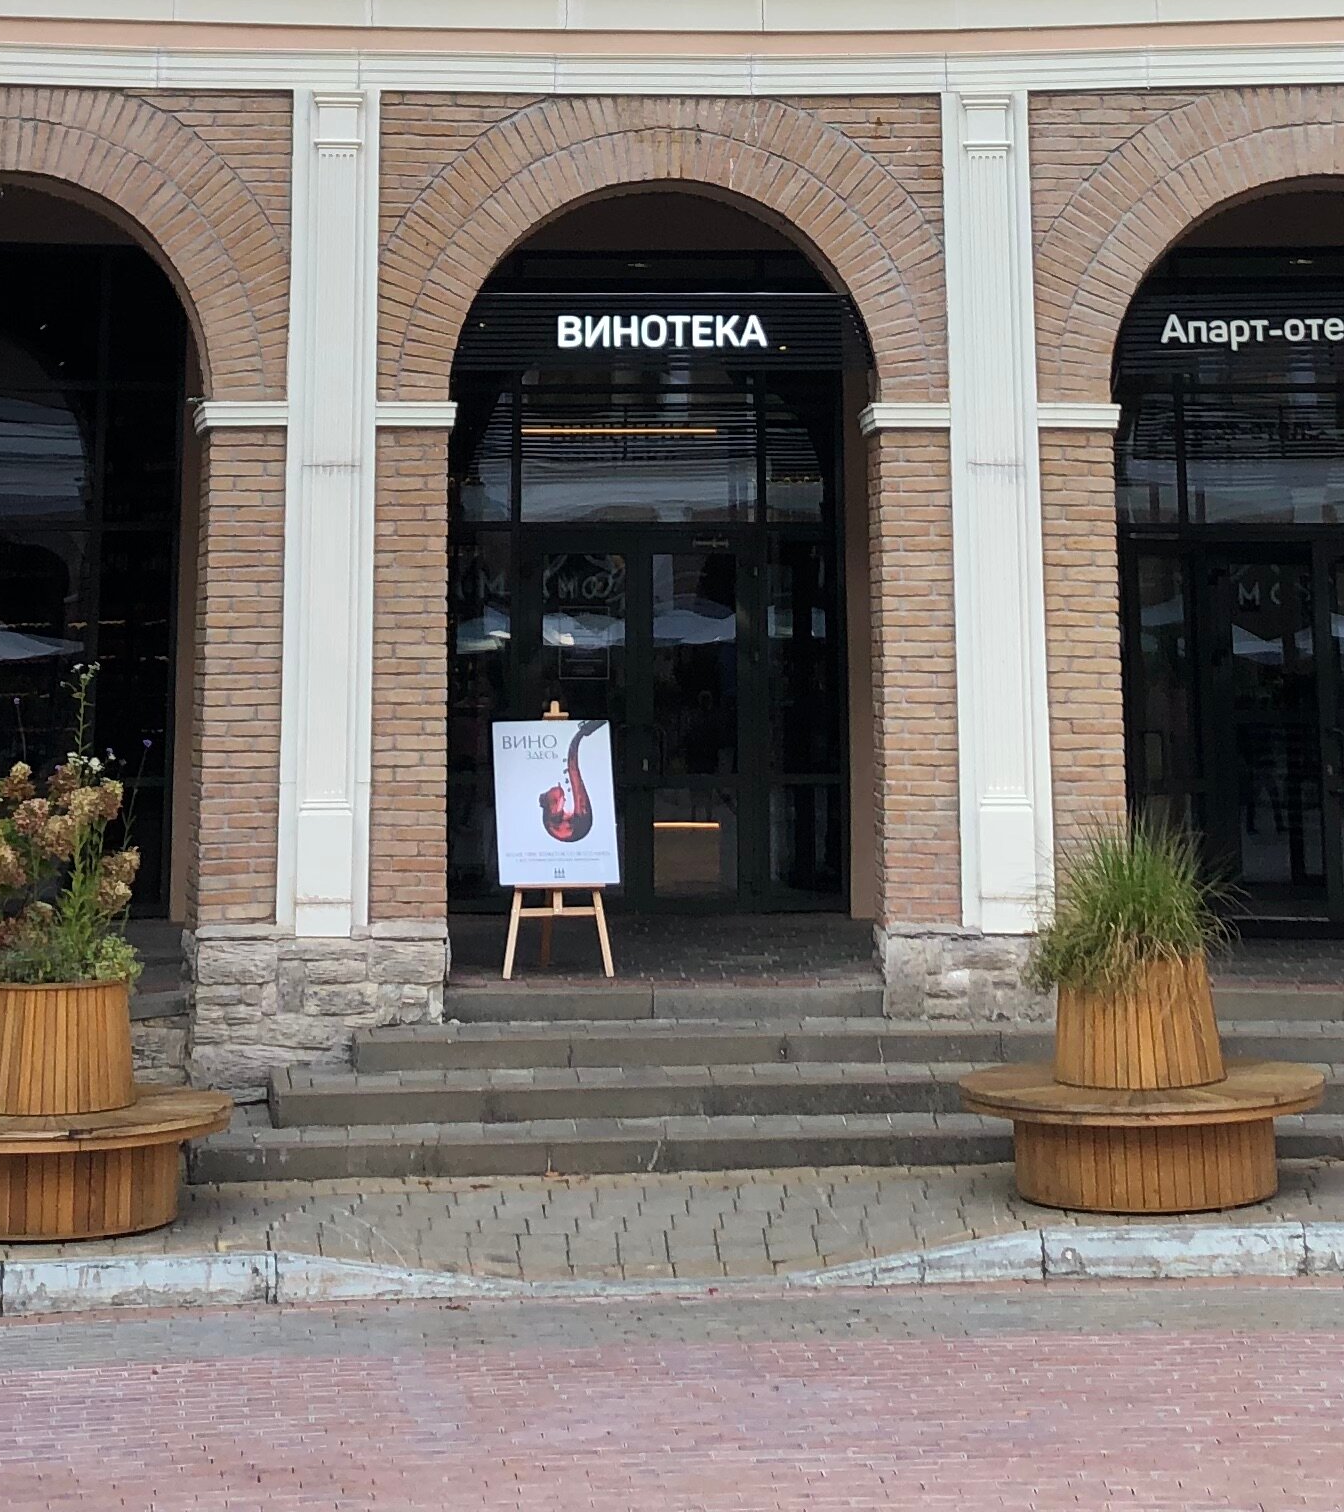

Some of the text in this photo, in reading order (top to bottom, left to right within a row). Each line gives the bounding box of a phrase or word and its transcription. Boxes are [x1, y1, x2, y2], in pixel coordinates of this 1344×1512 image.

[556, 314, 768, 349] ВИНОТЕКА
[501, 734, 558, 750] ВИНО
[525, 750, 559, 761] ЗДЕСЬ
